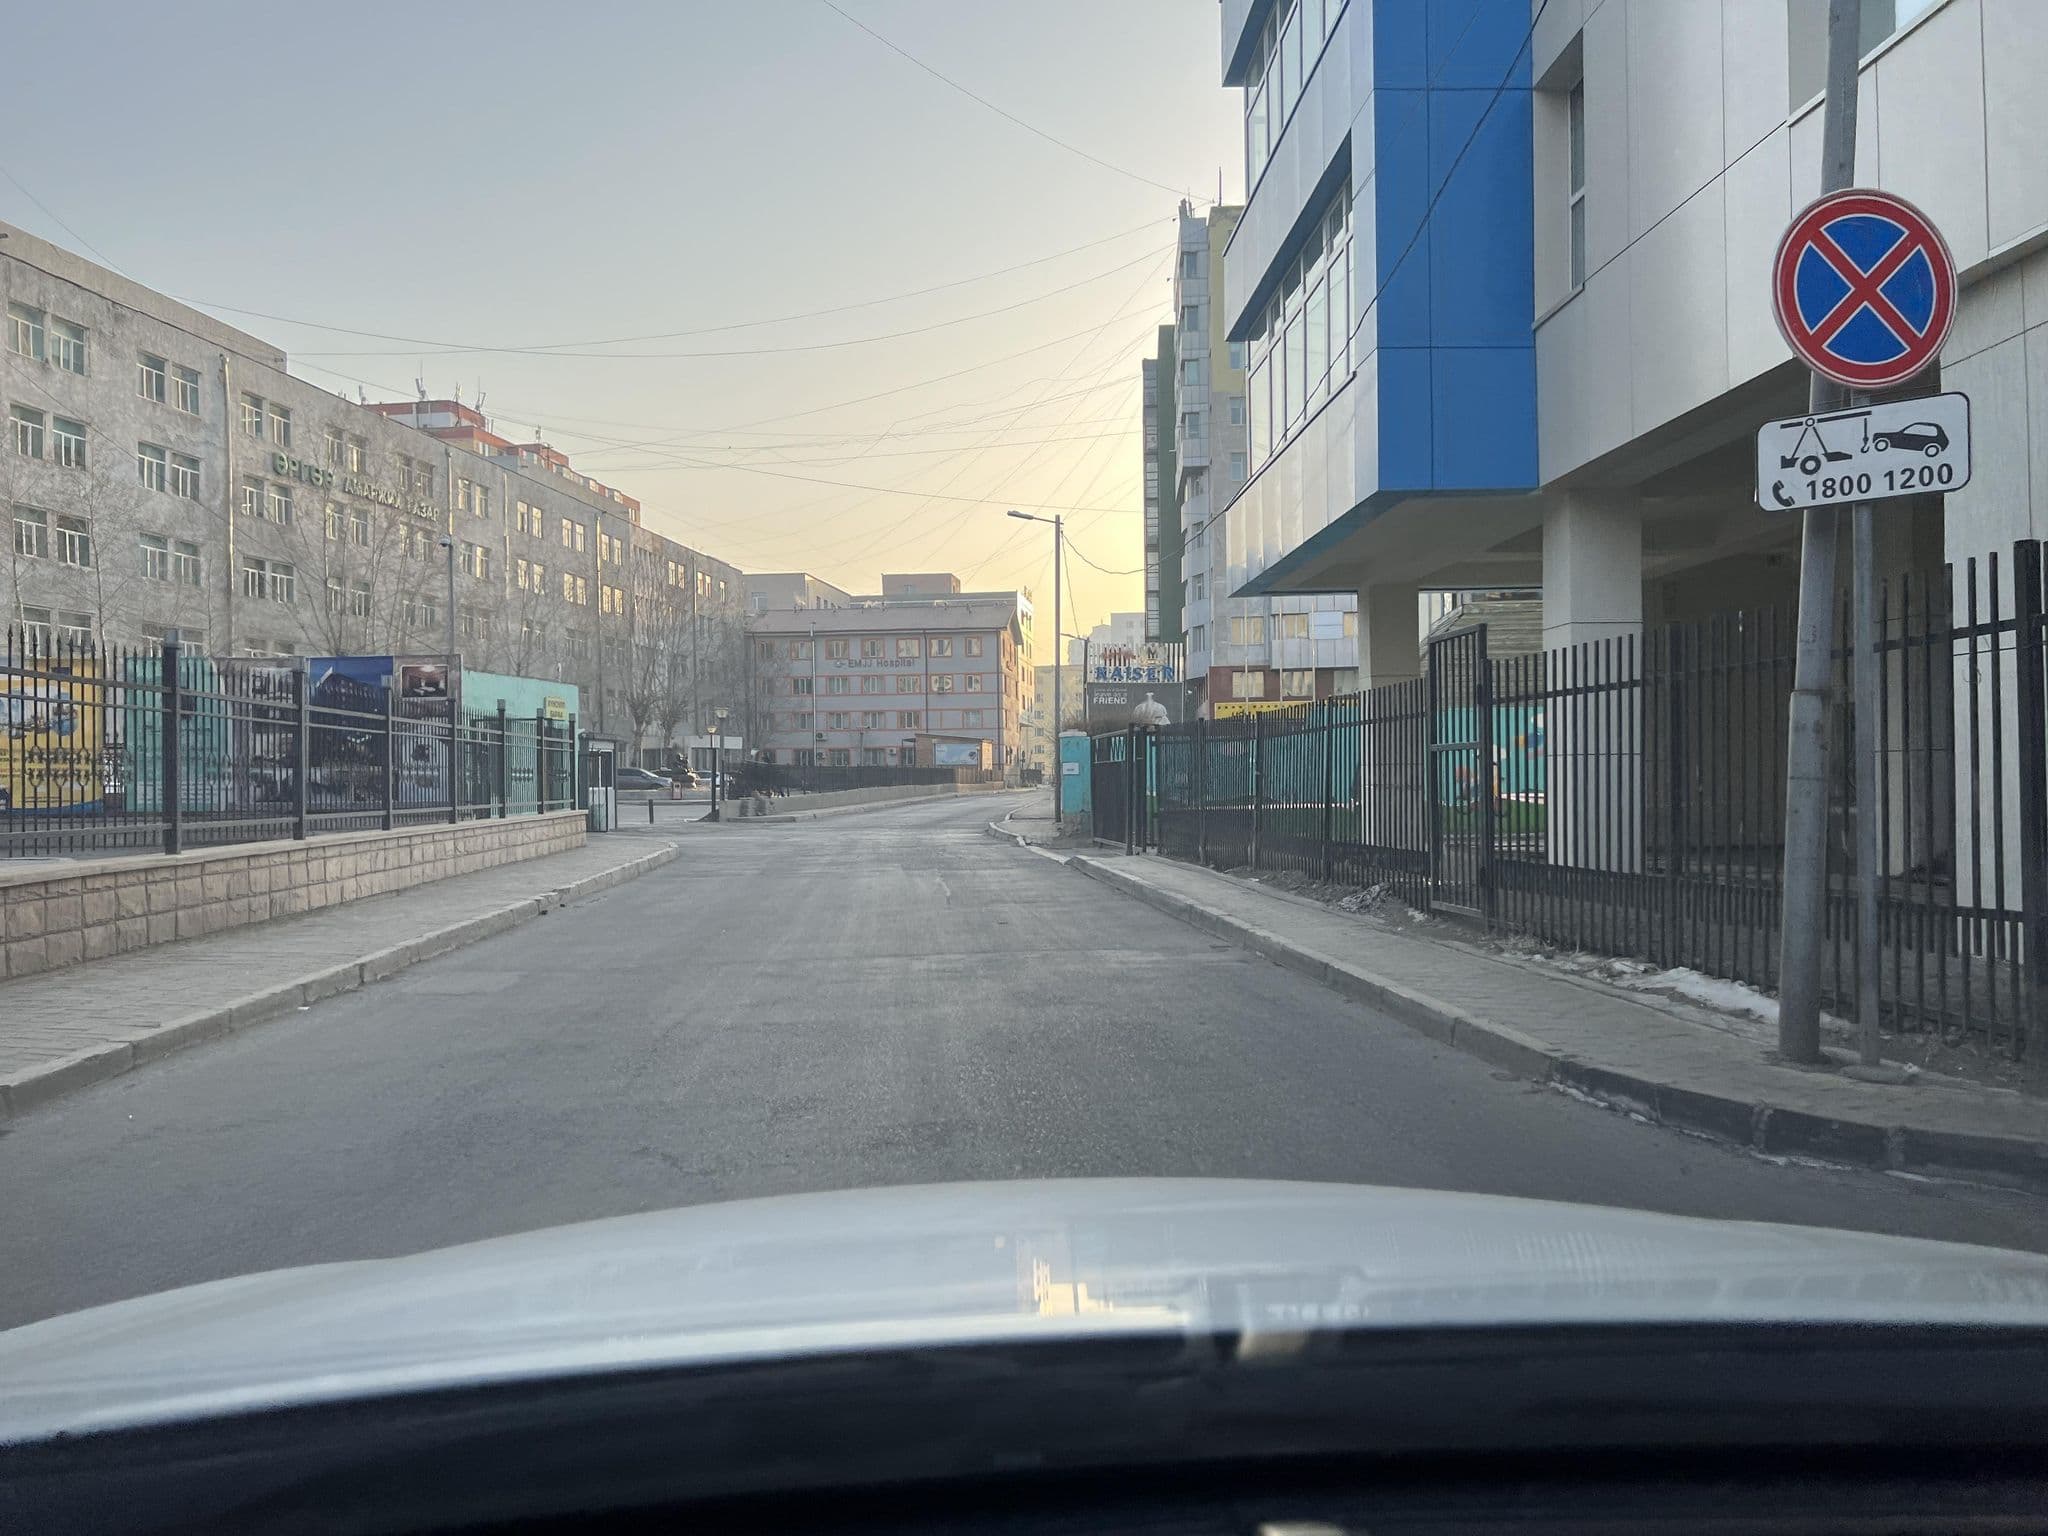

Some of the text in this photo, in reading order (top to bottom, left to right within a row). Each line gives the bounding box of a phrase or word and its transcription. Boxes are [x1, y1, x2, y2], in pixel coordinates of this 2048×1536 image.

[1806, 462, 1954, 501] 1800 1200
[848, 658, 915, 669] EMJJ Hospital
[1093, 696, 1128, 705] FRIEND
